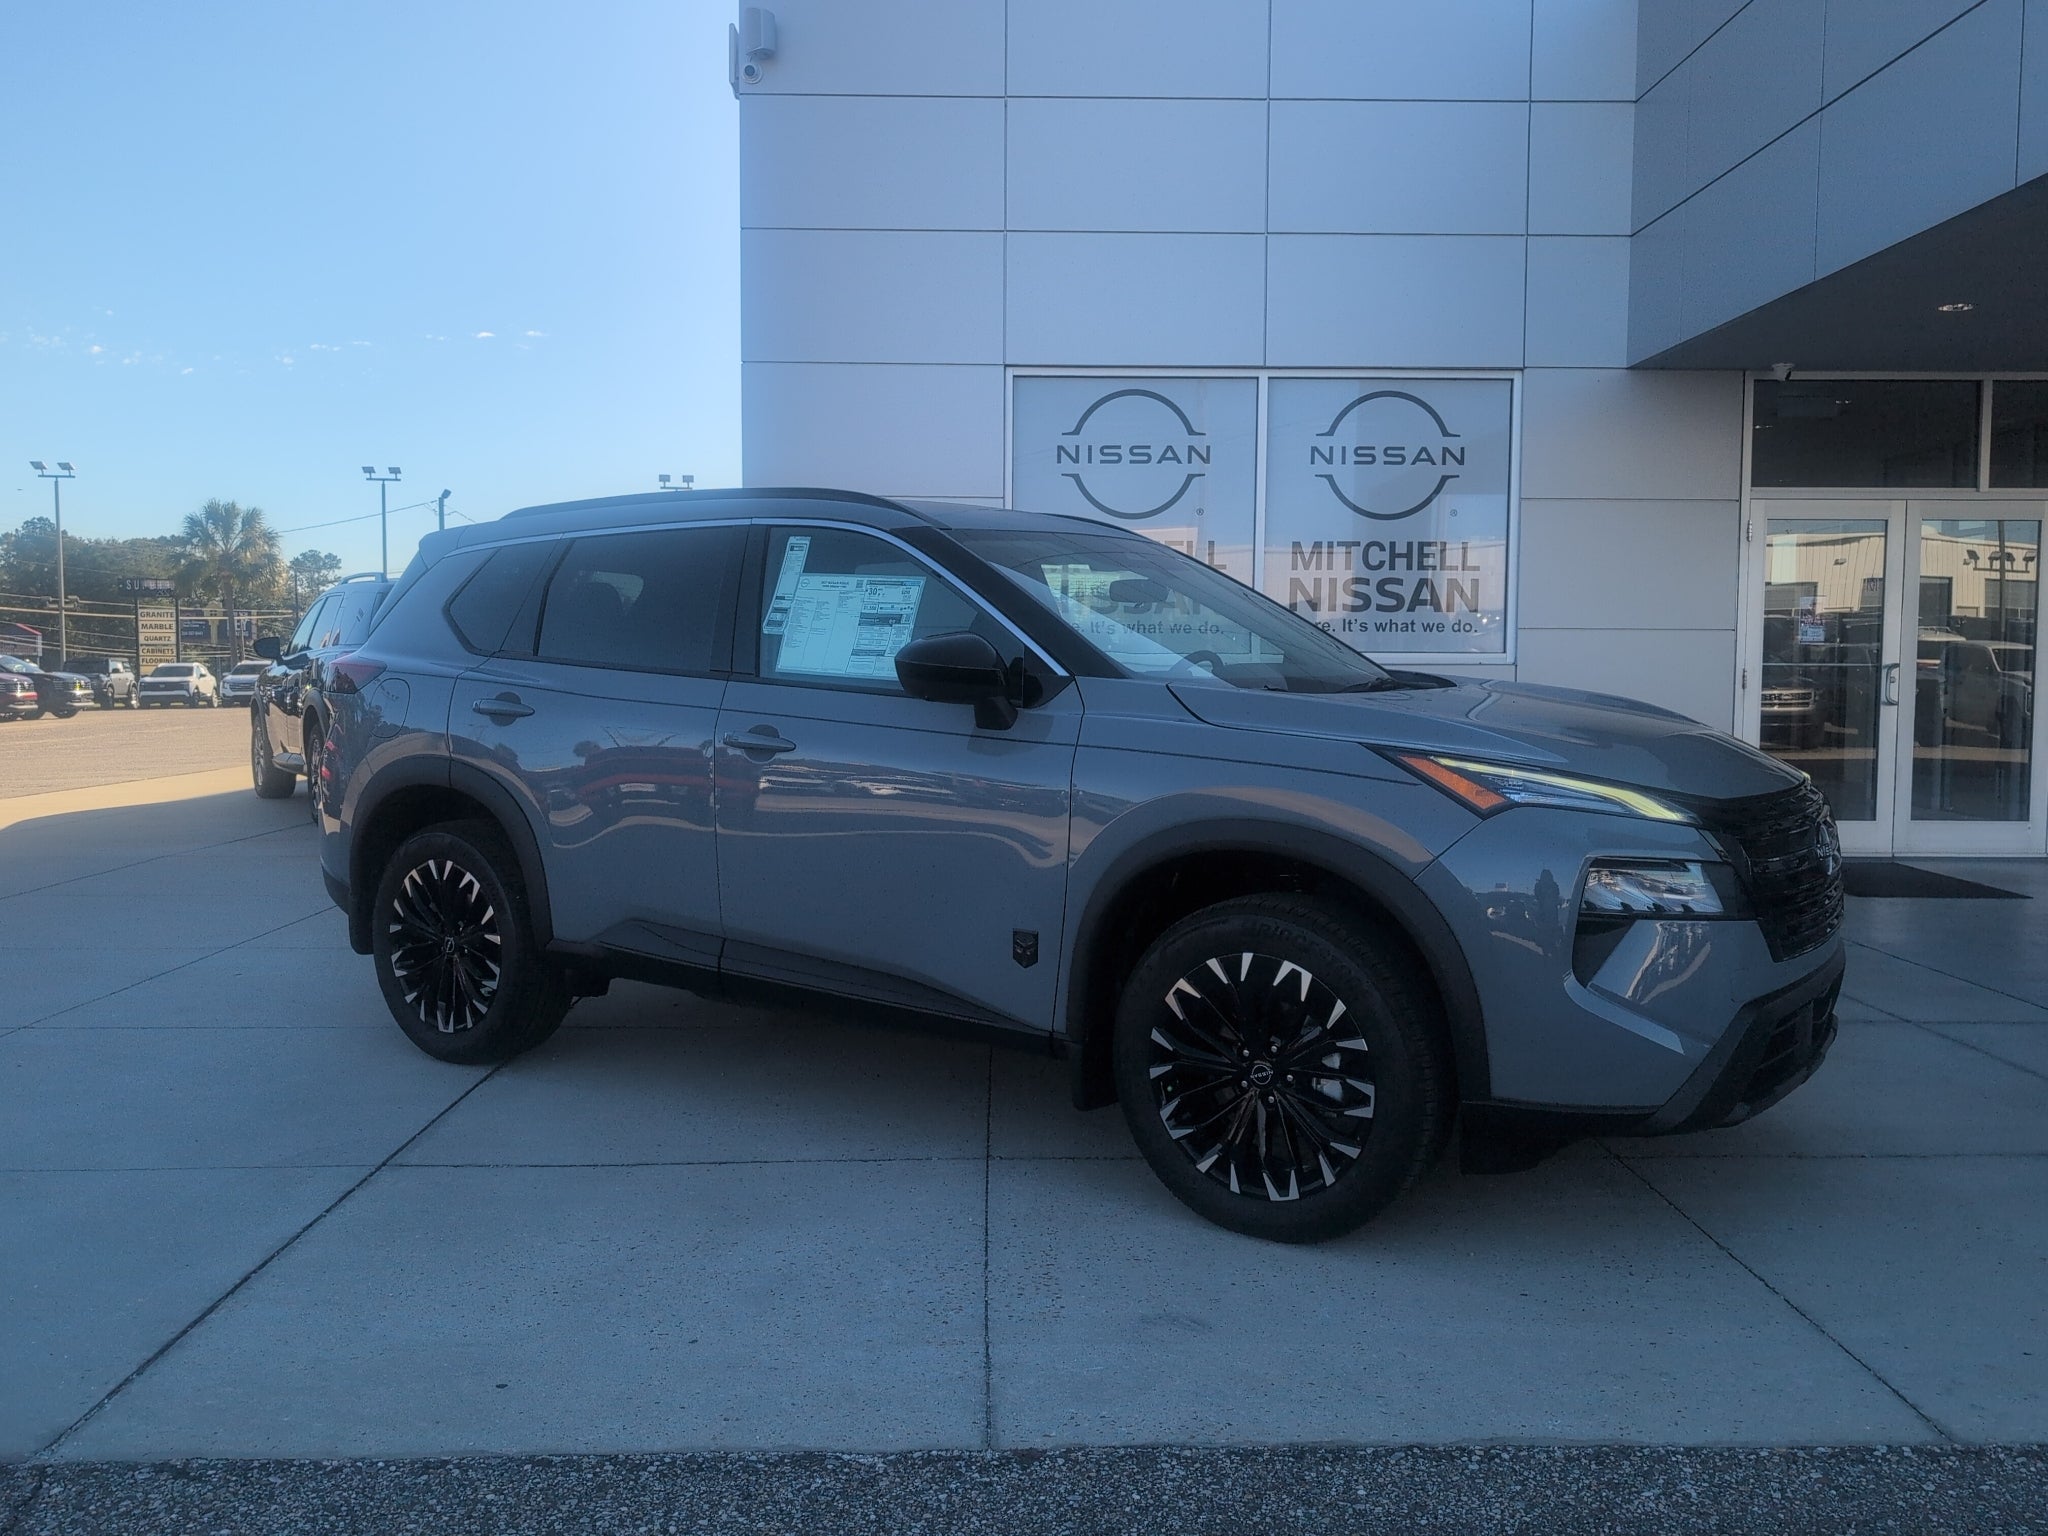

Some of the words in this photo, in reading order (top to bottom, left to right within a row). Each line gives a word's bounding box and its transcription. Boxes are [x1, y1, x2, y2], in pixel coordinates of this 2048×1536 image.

[1056, 444, 1211, 465] NISSAN
[1310, 445, 1465, 466] NISSAN
[1291, 540, 1481, 571] MITCHELL
[1288, 577, 1480, 613] NISSAN
[1121, 620, 1162, 634] what
[1169, 622, 1192, 634] we
[1198, 620, 1224, 634] do.
[1342, 618, 1369, 633] It's
[1375, 619, 1416, 633] what
[1421, 621, 1446, 633] we
[1451, 619, 1478, 633] do.
